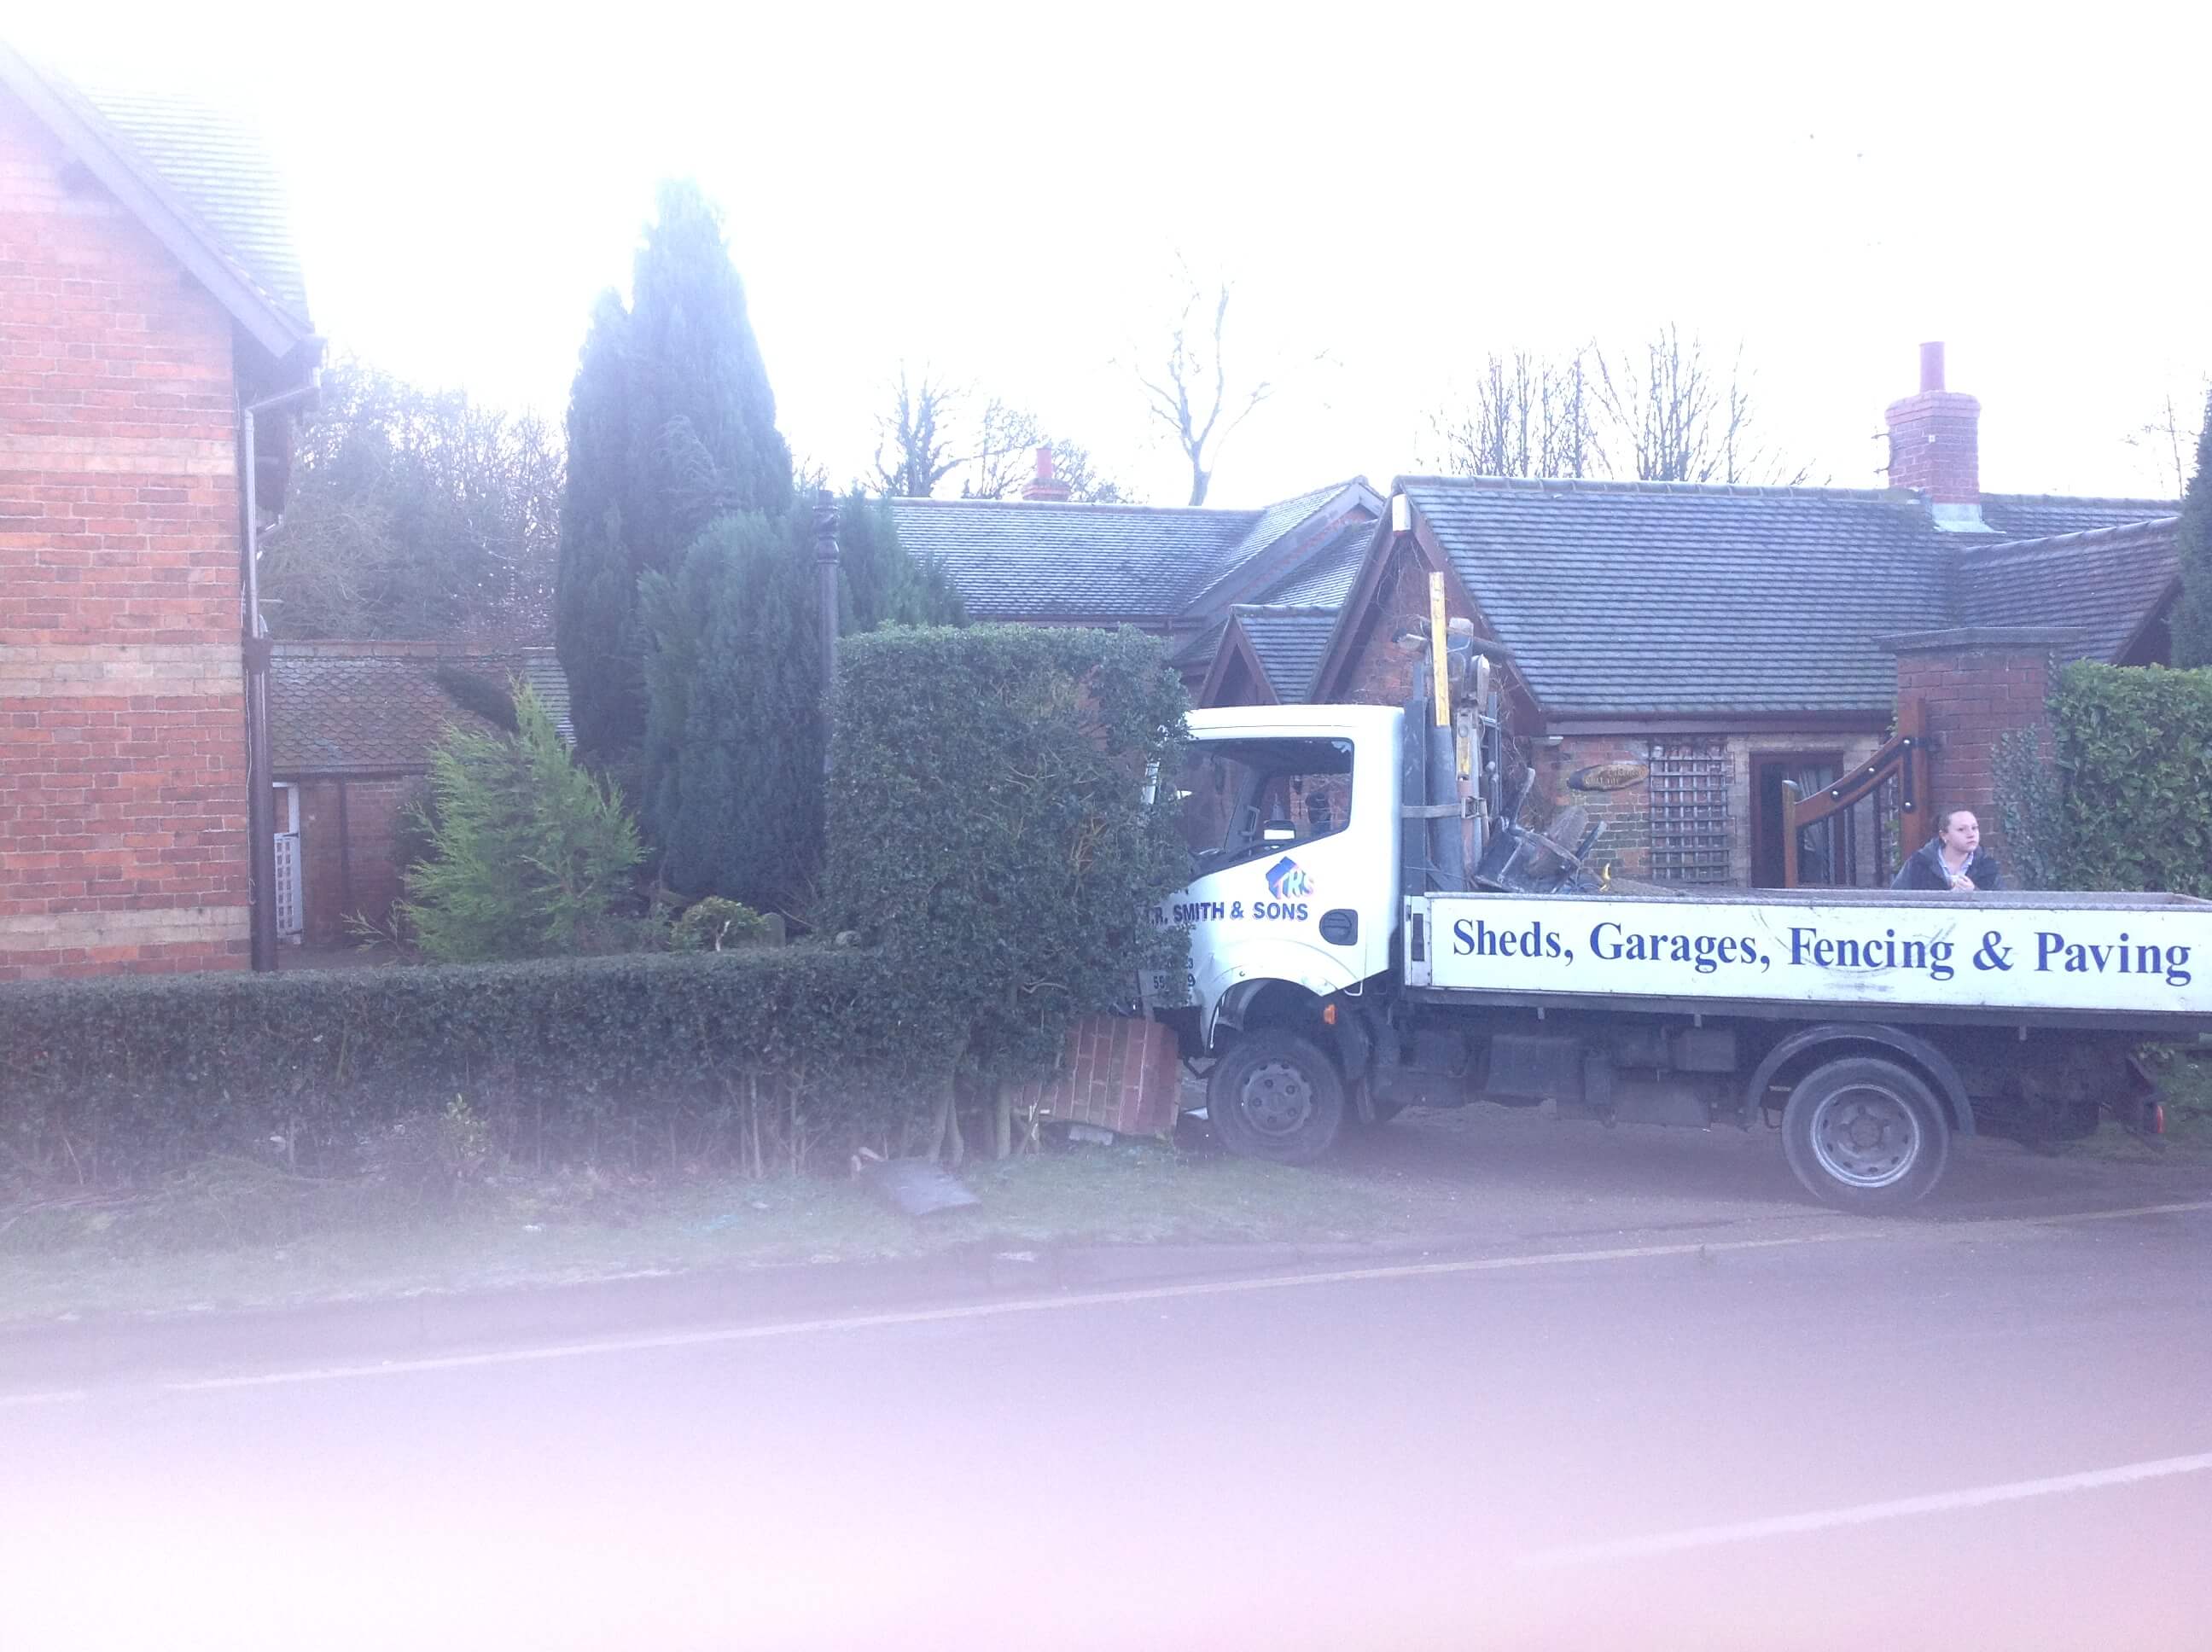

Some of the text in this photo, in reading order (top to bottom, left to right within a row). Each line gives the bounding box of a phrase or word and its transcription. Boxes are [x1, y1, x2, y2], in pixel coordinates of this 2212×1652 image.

[1173, 902, 1225, 924] SMITH
[1230, 901, 1244, 920] &
[1254, 901, 1308, 922] SONS
[1453, 918, 2192, 987] Sheds, Garages, Fencing & Paving
